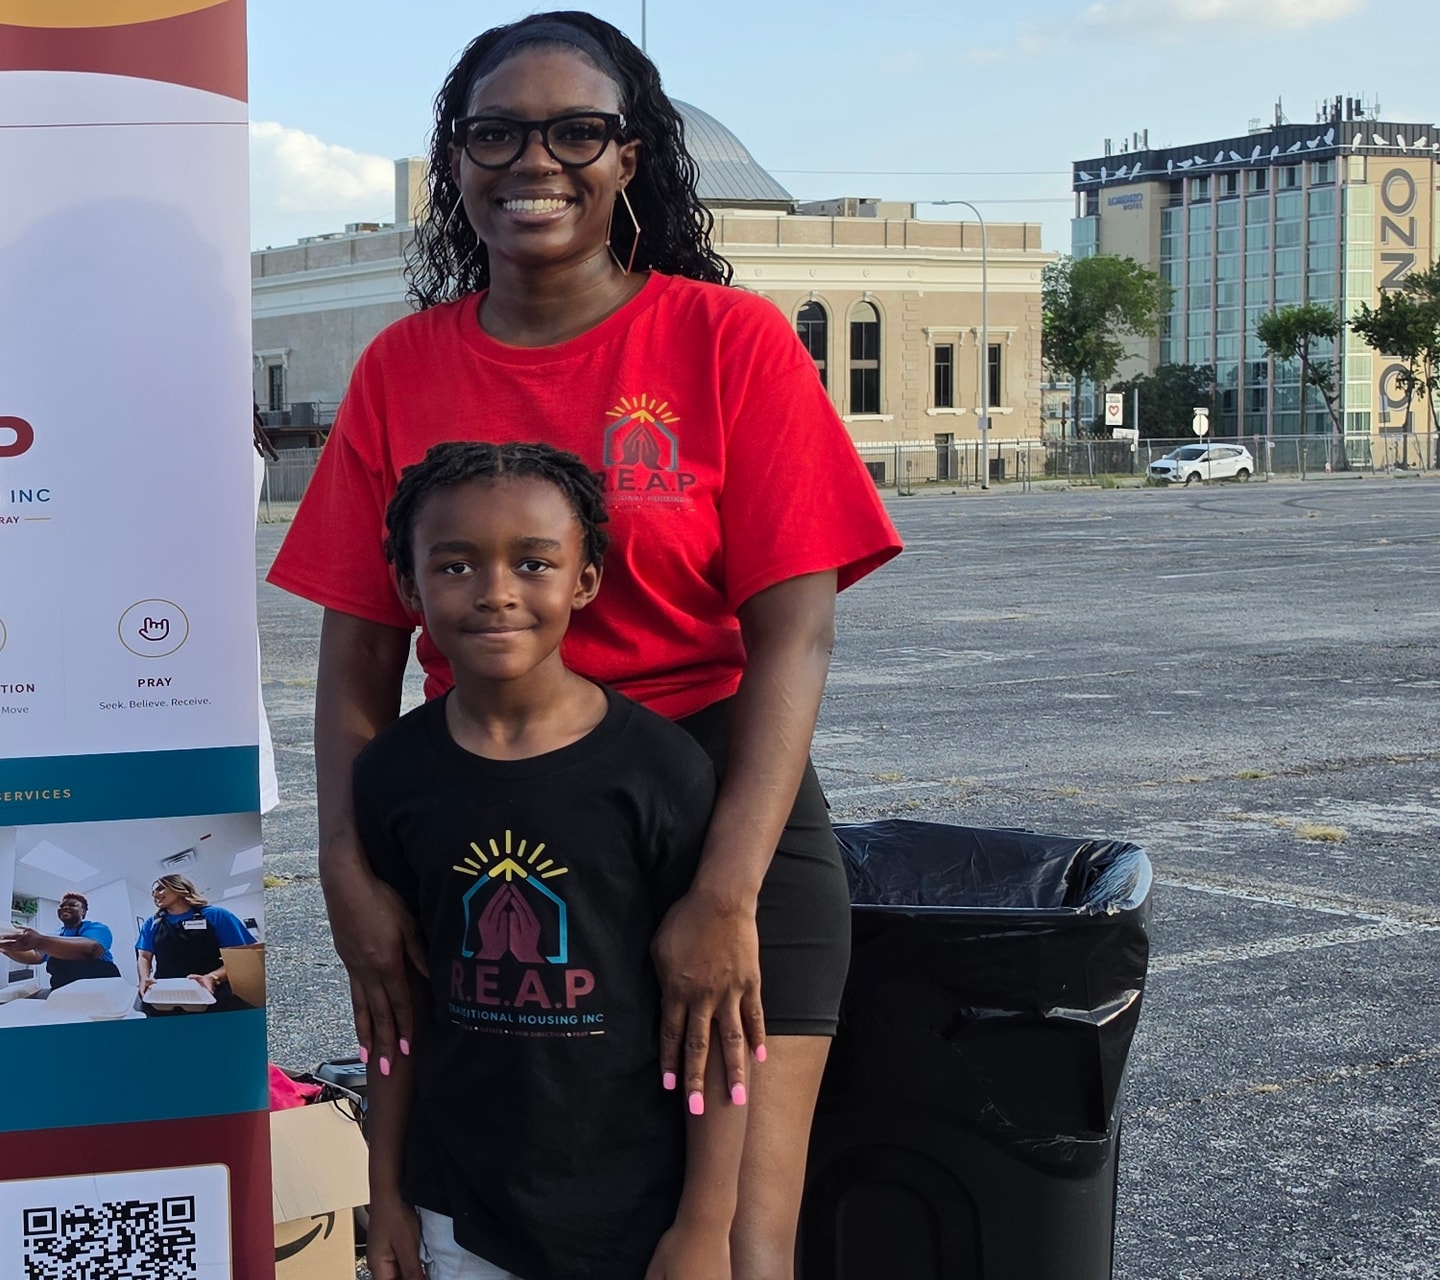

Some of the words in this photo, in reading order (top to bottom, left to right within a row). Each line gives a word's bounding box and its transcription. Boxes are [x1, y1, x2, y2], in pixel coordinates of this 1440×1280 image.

[11, 488, 51, 503] INC
[137, 678, 172, 688] PRAY
[99, 701, 126, 710] Seek.
[130, 699, 169, 709] Believe.
[171, 697, 211, 706] Receive.
[2, 705, 29, 714] Move
[451, 960, 595, 1008] R.E.A.P
[519, 1015, 577, 1024] HOUSING
[583, 1014, 604, 1023] INC
